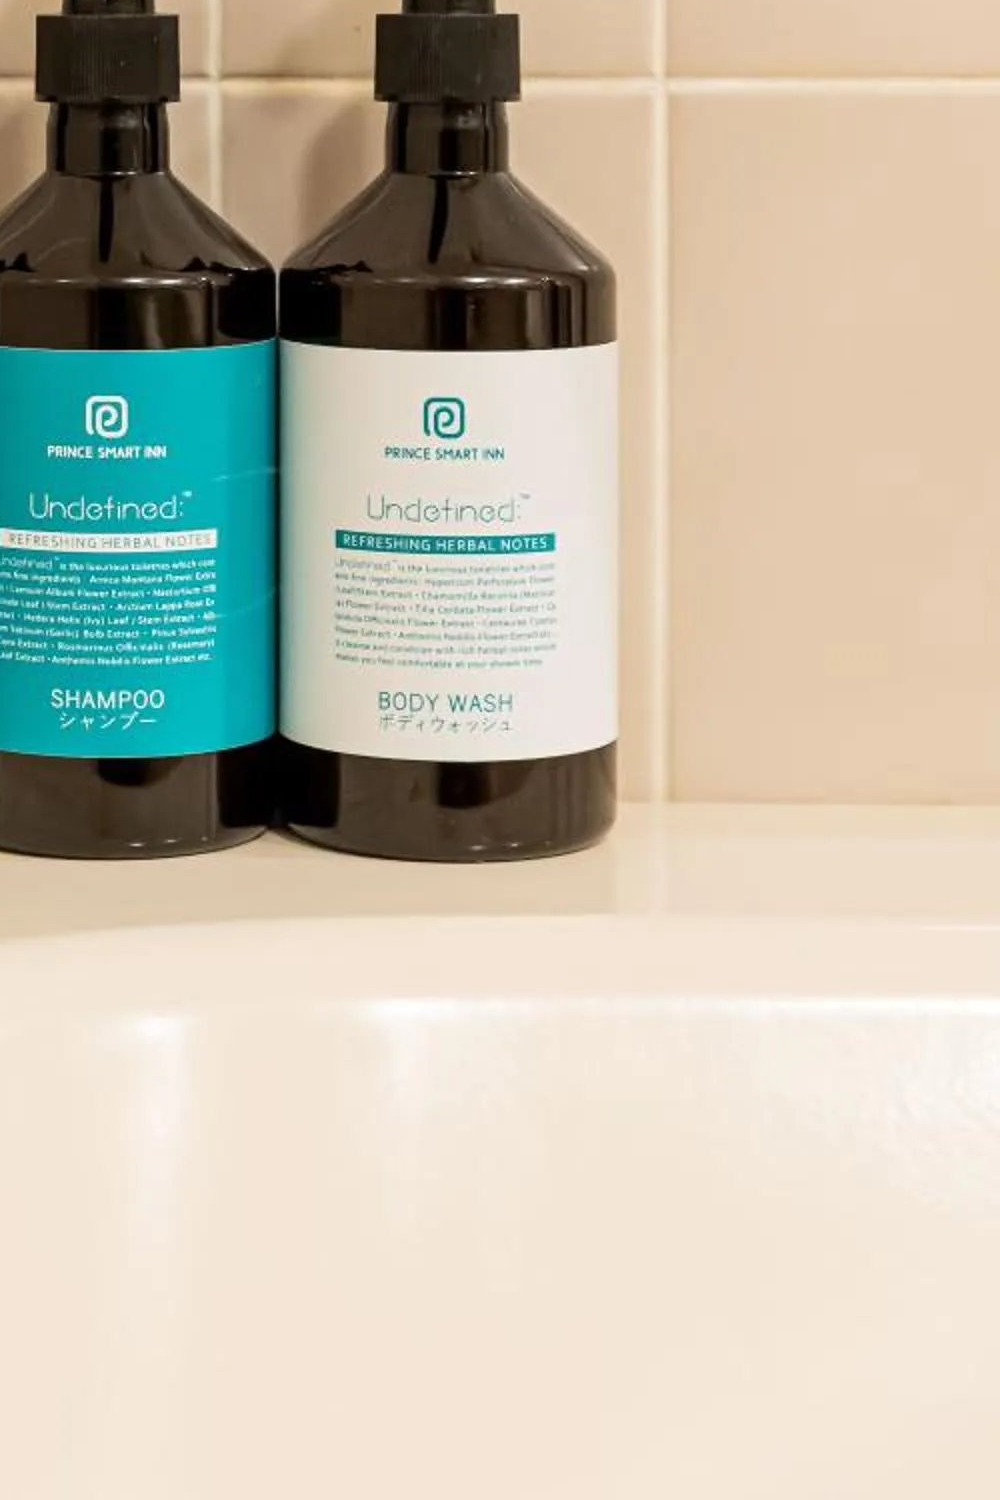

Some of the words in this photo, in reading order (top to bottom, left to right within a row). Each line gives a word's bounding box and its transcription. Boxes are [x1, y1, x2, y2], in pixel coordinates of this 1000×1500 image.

[47, 445, 93, 459] PRINCE
[98, 446, 140, 459] SMART
[143, 446, 167, 459] INN
[384, 446, 431, 461] PRINCE
[435, 448, 478, 461] SMART
[482, 448, 505, 460] INN
[8, 532, 98, 549] REFRESHING
[101, 535, 161, 550] HERBAL
[164, 532, 212, 548] NOTES
[343, 533, 431, 550] REFRESHING
[436, 537, 496, 551] HERBAL
[501, 536, 548, 550] NOTES
[51, 688, 165, 710] SHAMPOO
[378, 691, 439, 711] BODY
[447, 693, 514, 713] WASH
